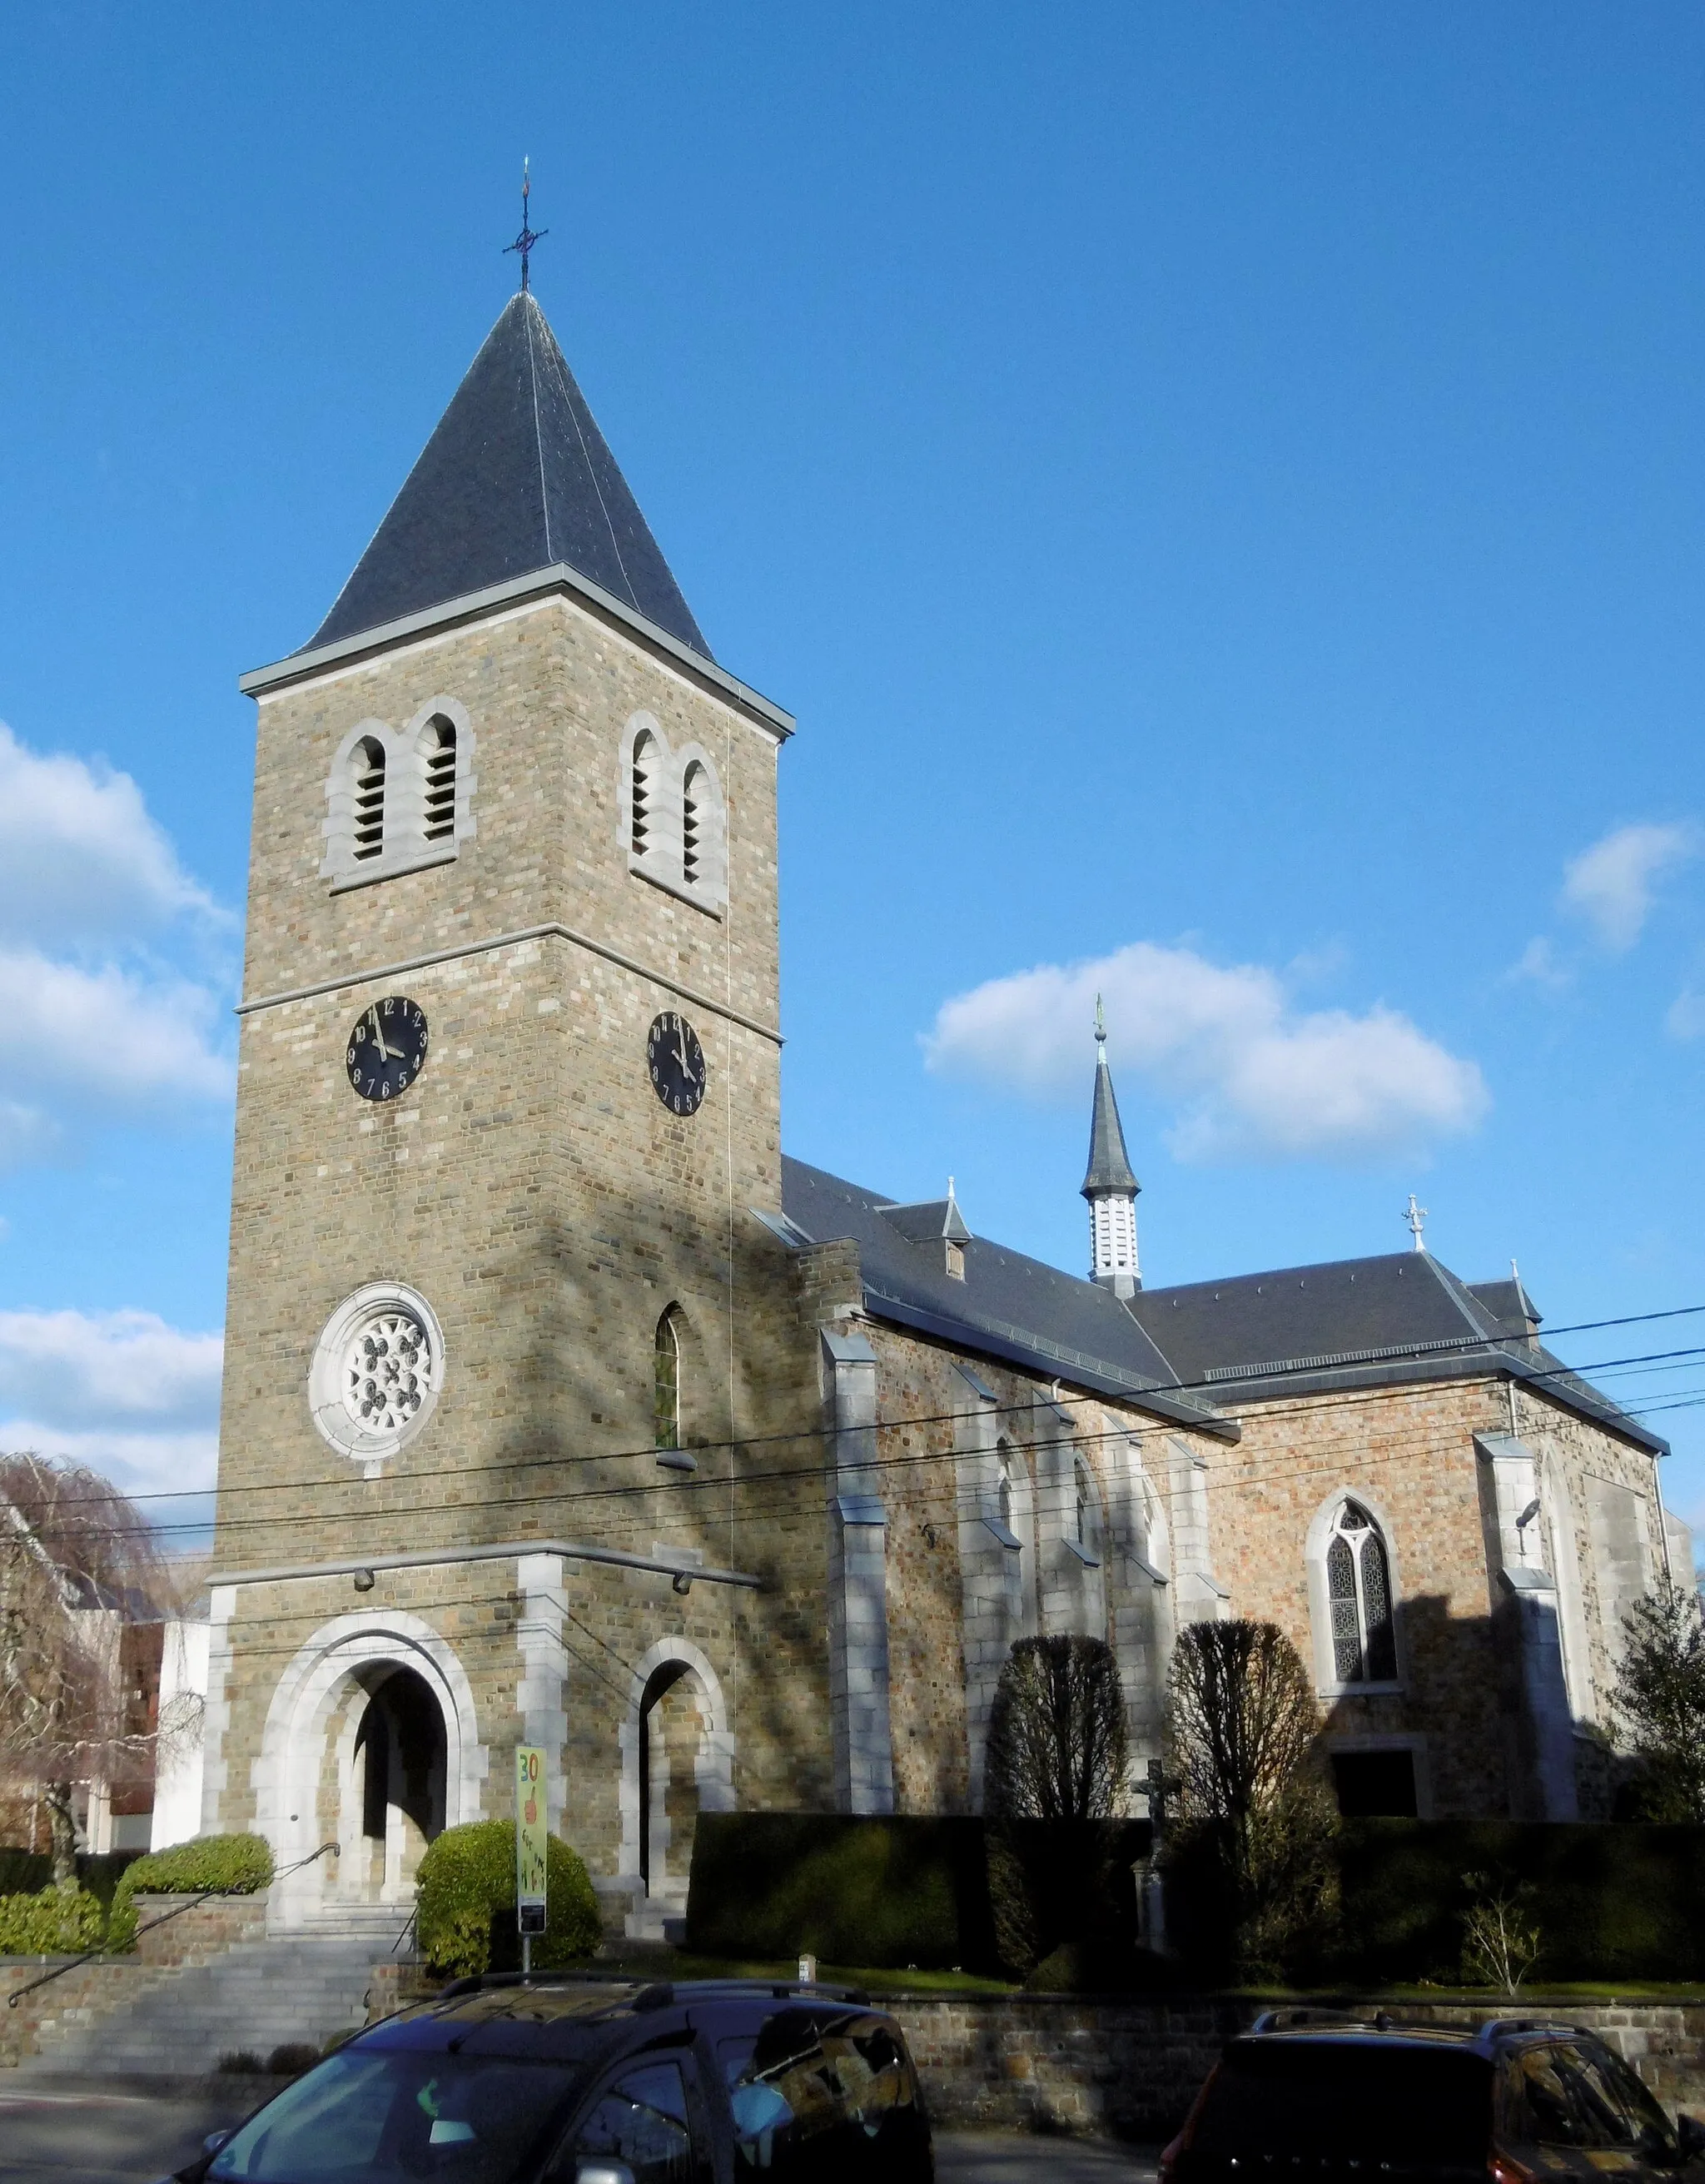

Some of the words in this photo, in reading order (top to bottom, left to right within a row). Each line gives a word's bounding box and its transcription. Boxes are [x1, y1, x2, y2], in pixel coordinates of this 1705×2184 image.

[383, 998, 395, 1016] 12
[402, 1000, 408, 1017] 1
[414, 1010, 422, 1027] 2
[661, 1015, 668, 1032] 11
[355, 1025, 365, 1042] 10
[420, 1031, 428, 1047] 3
[652, 1025, 661, 1042] 10
[686, 1026, 691, 1042] 1
[347, 1047, 355, 1064] 9
[649, 1042, 654, 1059] 9
[693, 1043, 700, 1060] 2
[412, 1054, 420, 1071] 4
[353, 1067, 361, 1084] 8
[398, 1071, 407, 1088] 5
[652, 1066, 659, 1082] 8
[699, 1067, 706, 1082] 3
[366, 1078, 375, 1096] 7
[381, 1081, 390, 1098] 6
[663, 1084, 669, 1101] 7
[695, 1086, 701, 1102] 4
[674, 1095, 681, 1112] 6
[686, 1094, 693, 1112] 5
[519, 1753, 539, 1782] 30
[1264, 2153, 1391, 2172] VOLVO
